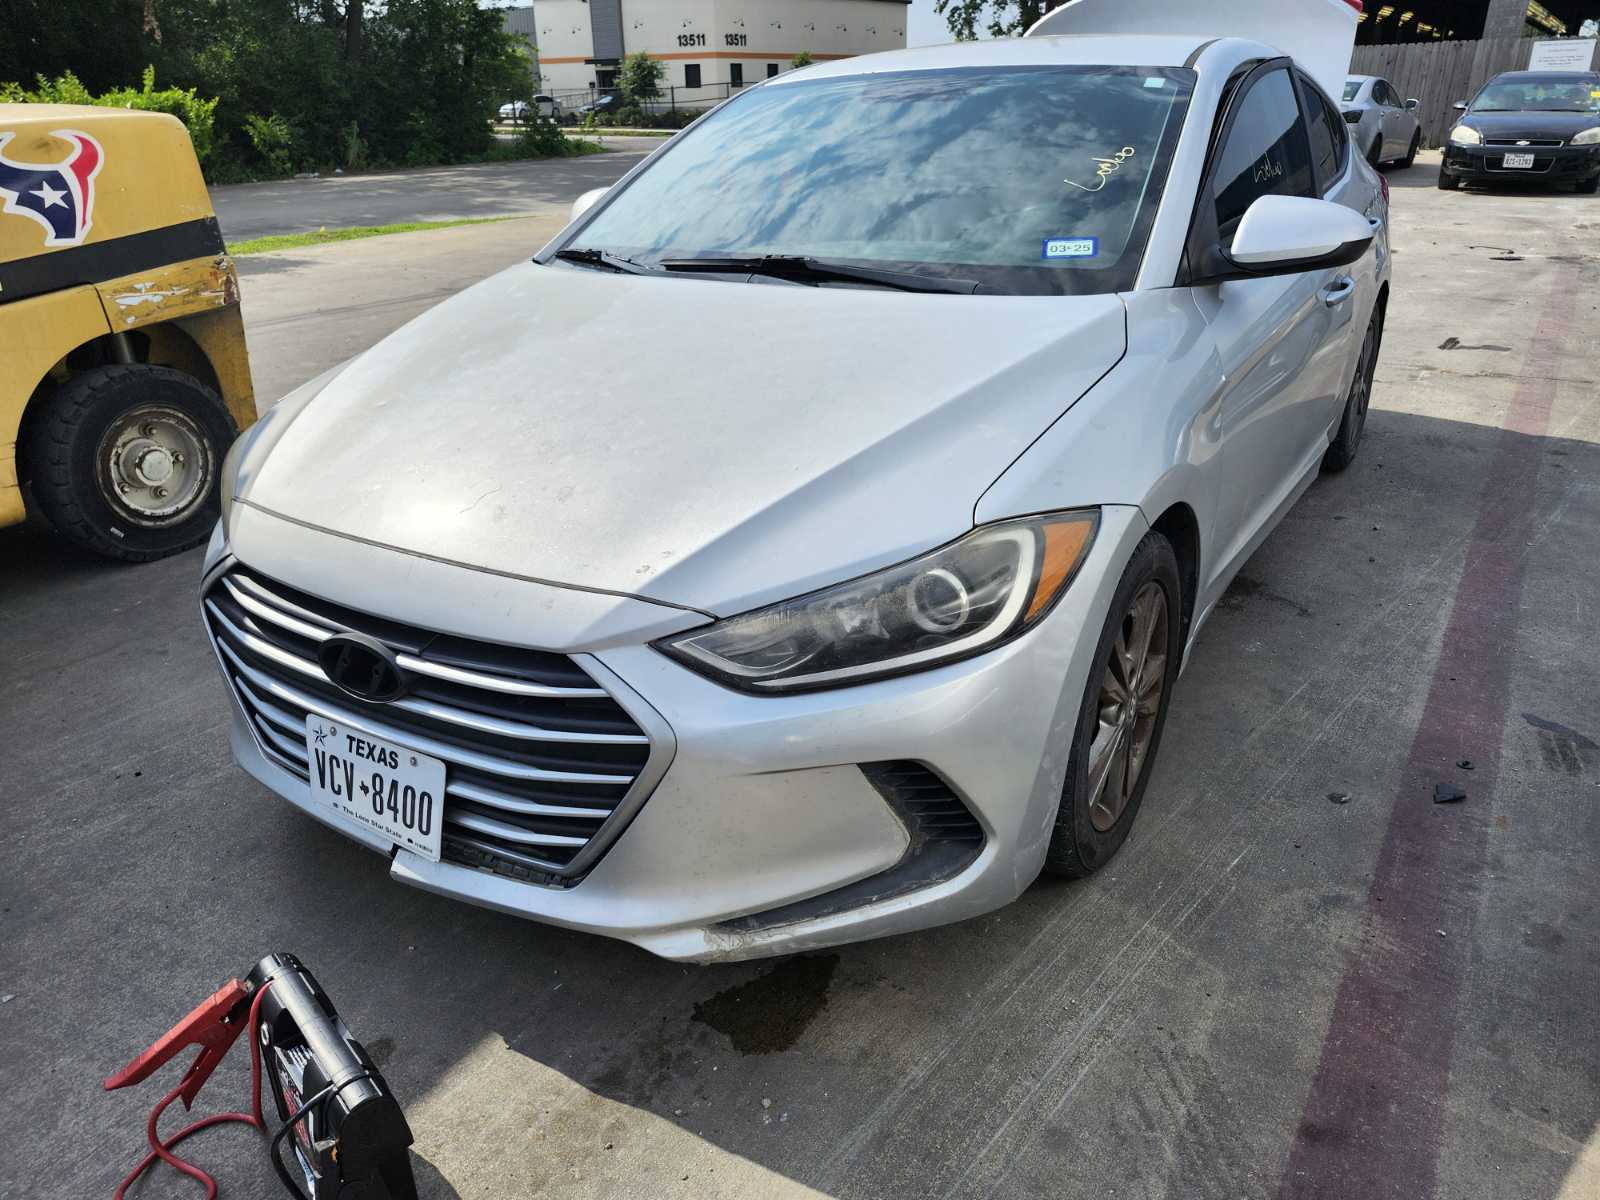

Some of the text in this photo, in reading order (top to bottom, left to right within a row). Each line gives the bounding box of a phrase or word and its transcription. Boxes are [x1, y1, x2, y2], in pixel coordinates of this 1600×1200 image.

[677, 34, 706, 47] 13511
[724, 33, 747, 47] 13511
[346, 734, 399, 770] TEXAS
[314, 748, 433, 836] VCV 8400
[342, 806, 402, 839] The Lone Star State
